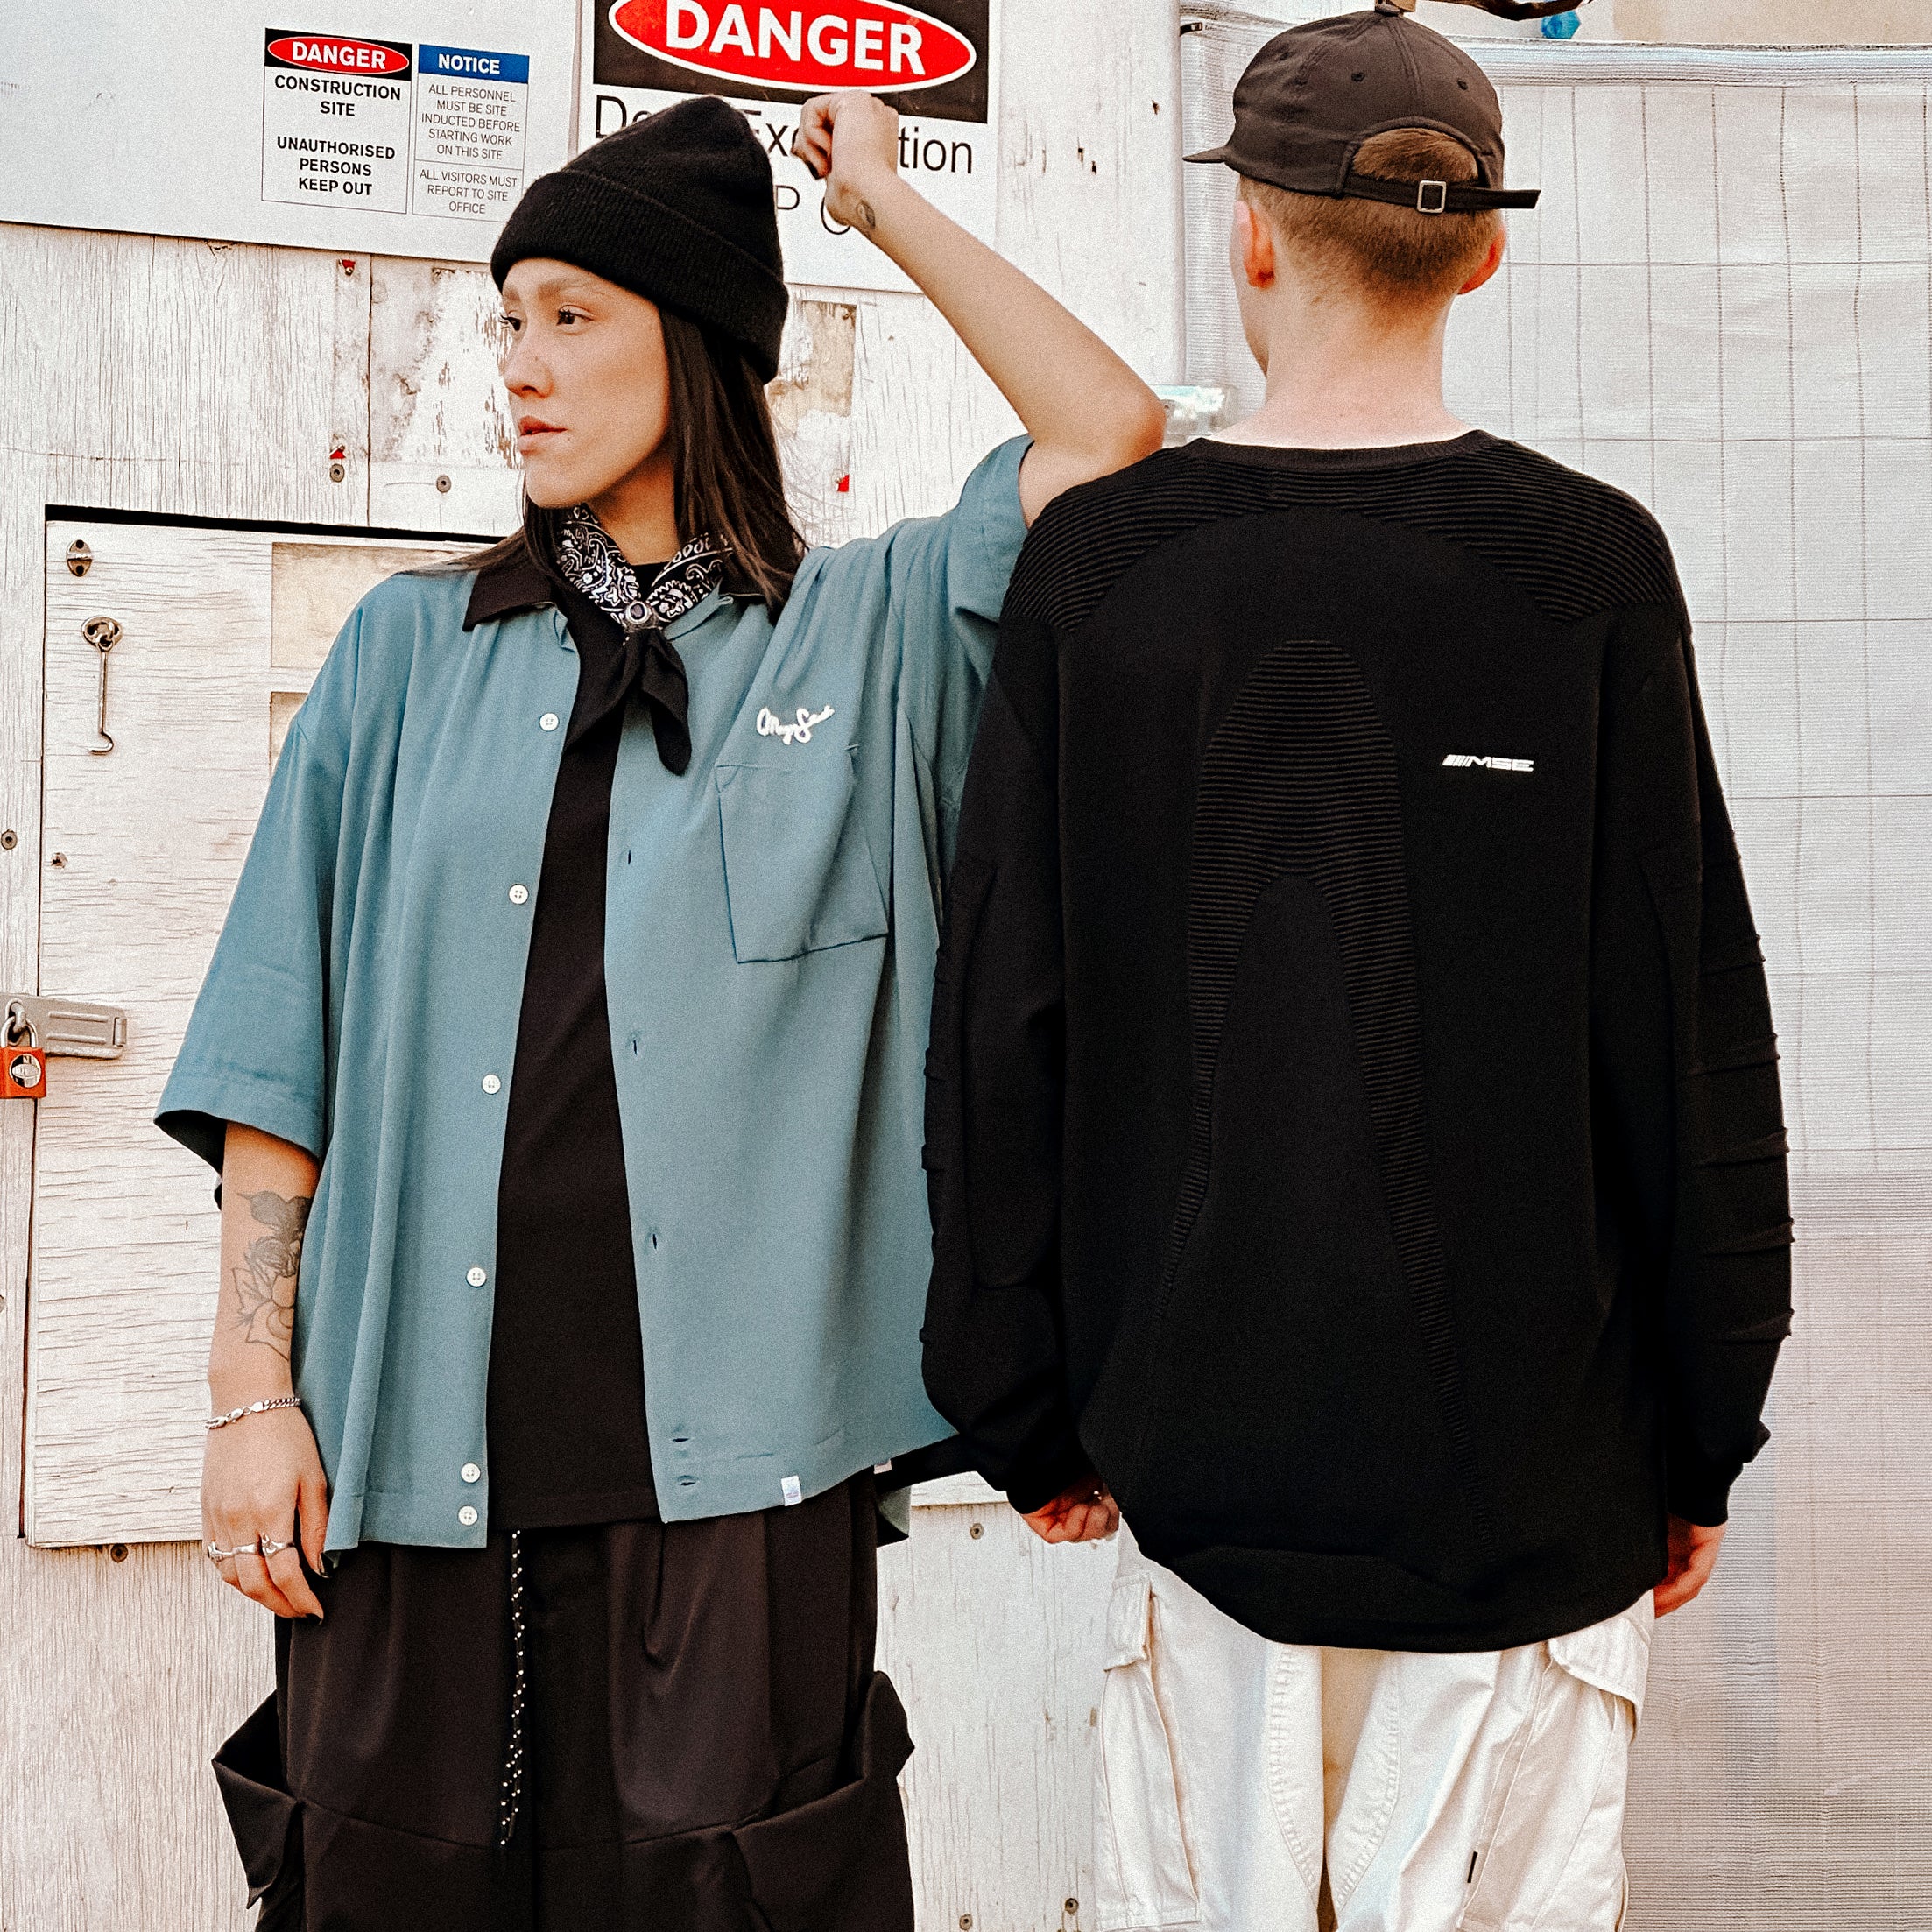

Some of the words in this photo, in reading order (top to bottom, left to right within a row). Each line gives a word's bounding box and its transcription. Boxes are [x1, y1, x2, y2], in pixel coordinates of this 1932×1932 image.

[666, 0, 927, 76] DANGER
[292, 41, 386, 70] DANGER
[438, 53, 501, 74] NOTICE
[274, 74, 401, 100] CONSTRUCTION
[428, 83, 448, 95] ALL
[450, 86, 517, 102] PERSONNEL
[320, 101, 356, 117] SITE
[436, 99, 466, 112] MUST
[469, 102, 483, 114] BE
[485, 104, 508, 116] SITE
[421, 113, 476, 128] INDUCTED
[478, 118, 520, 133] BEFORE
[428, 128, 478, 143] STARTING
[481, 133, 513, 146] WORK
[277, 136, 396, 159] UNAUTHORISED
[436, 144, 453, 155] ON
[455, 145, 479, 158] THIS
[481, 148, 504, 160] SITE
[300, 158, 372, 176] PERSONS
[298, 177, 339, 192] KEEP
[342, 181, 373, 195] OUT
[420, 169, 438, 180] ALL
[441, 171, 487, 186] VISITORS
[490, 175, 518, 187] MUST
[427, 184, 469, 198] REPORT
[471, 187, 485, 200] TO
[487, 190, 509, 201] SITE
[448, 201, 486, 215] OFFICE
